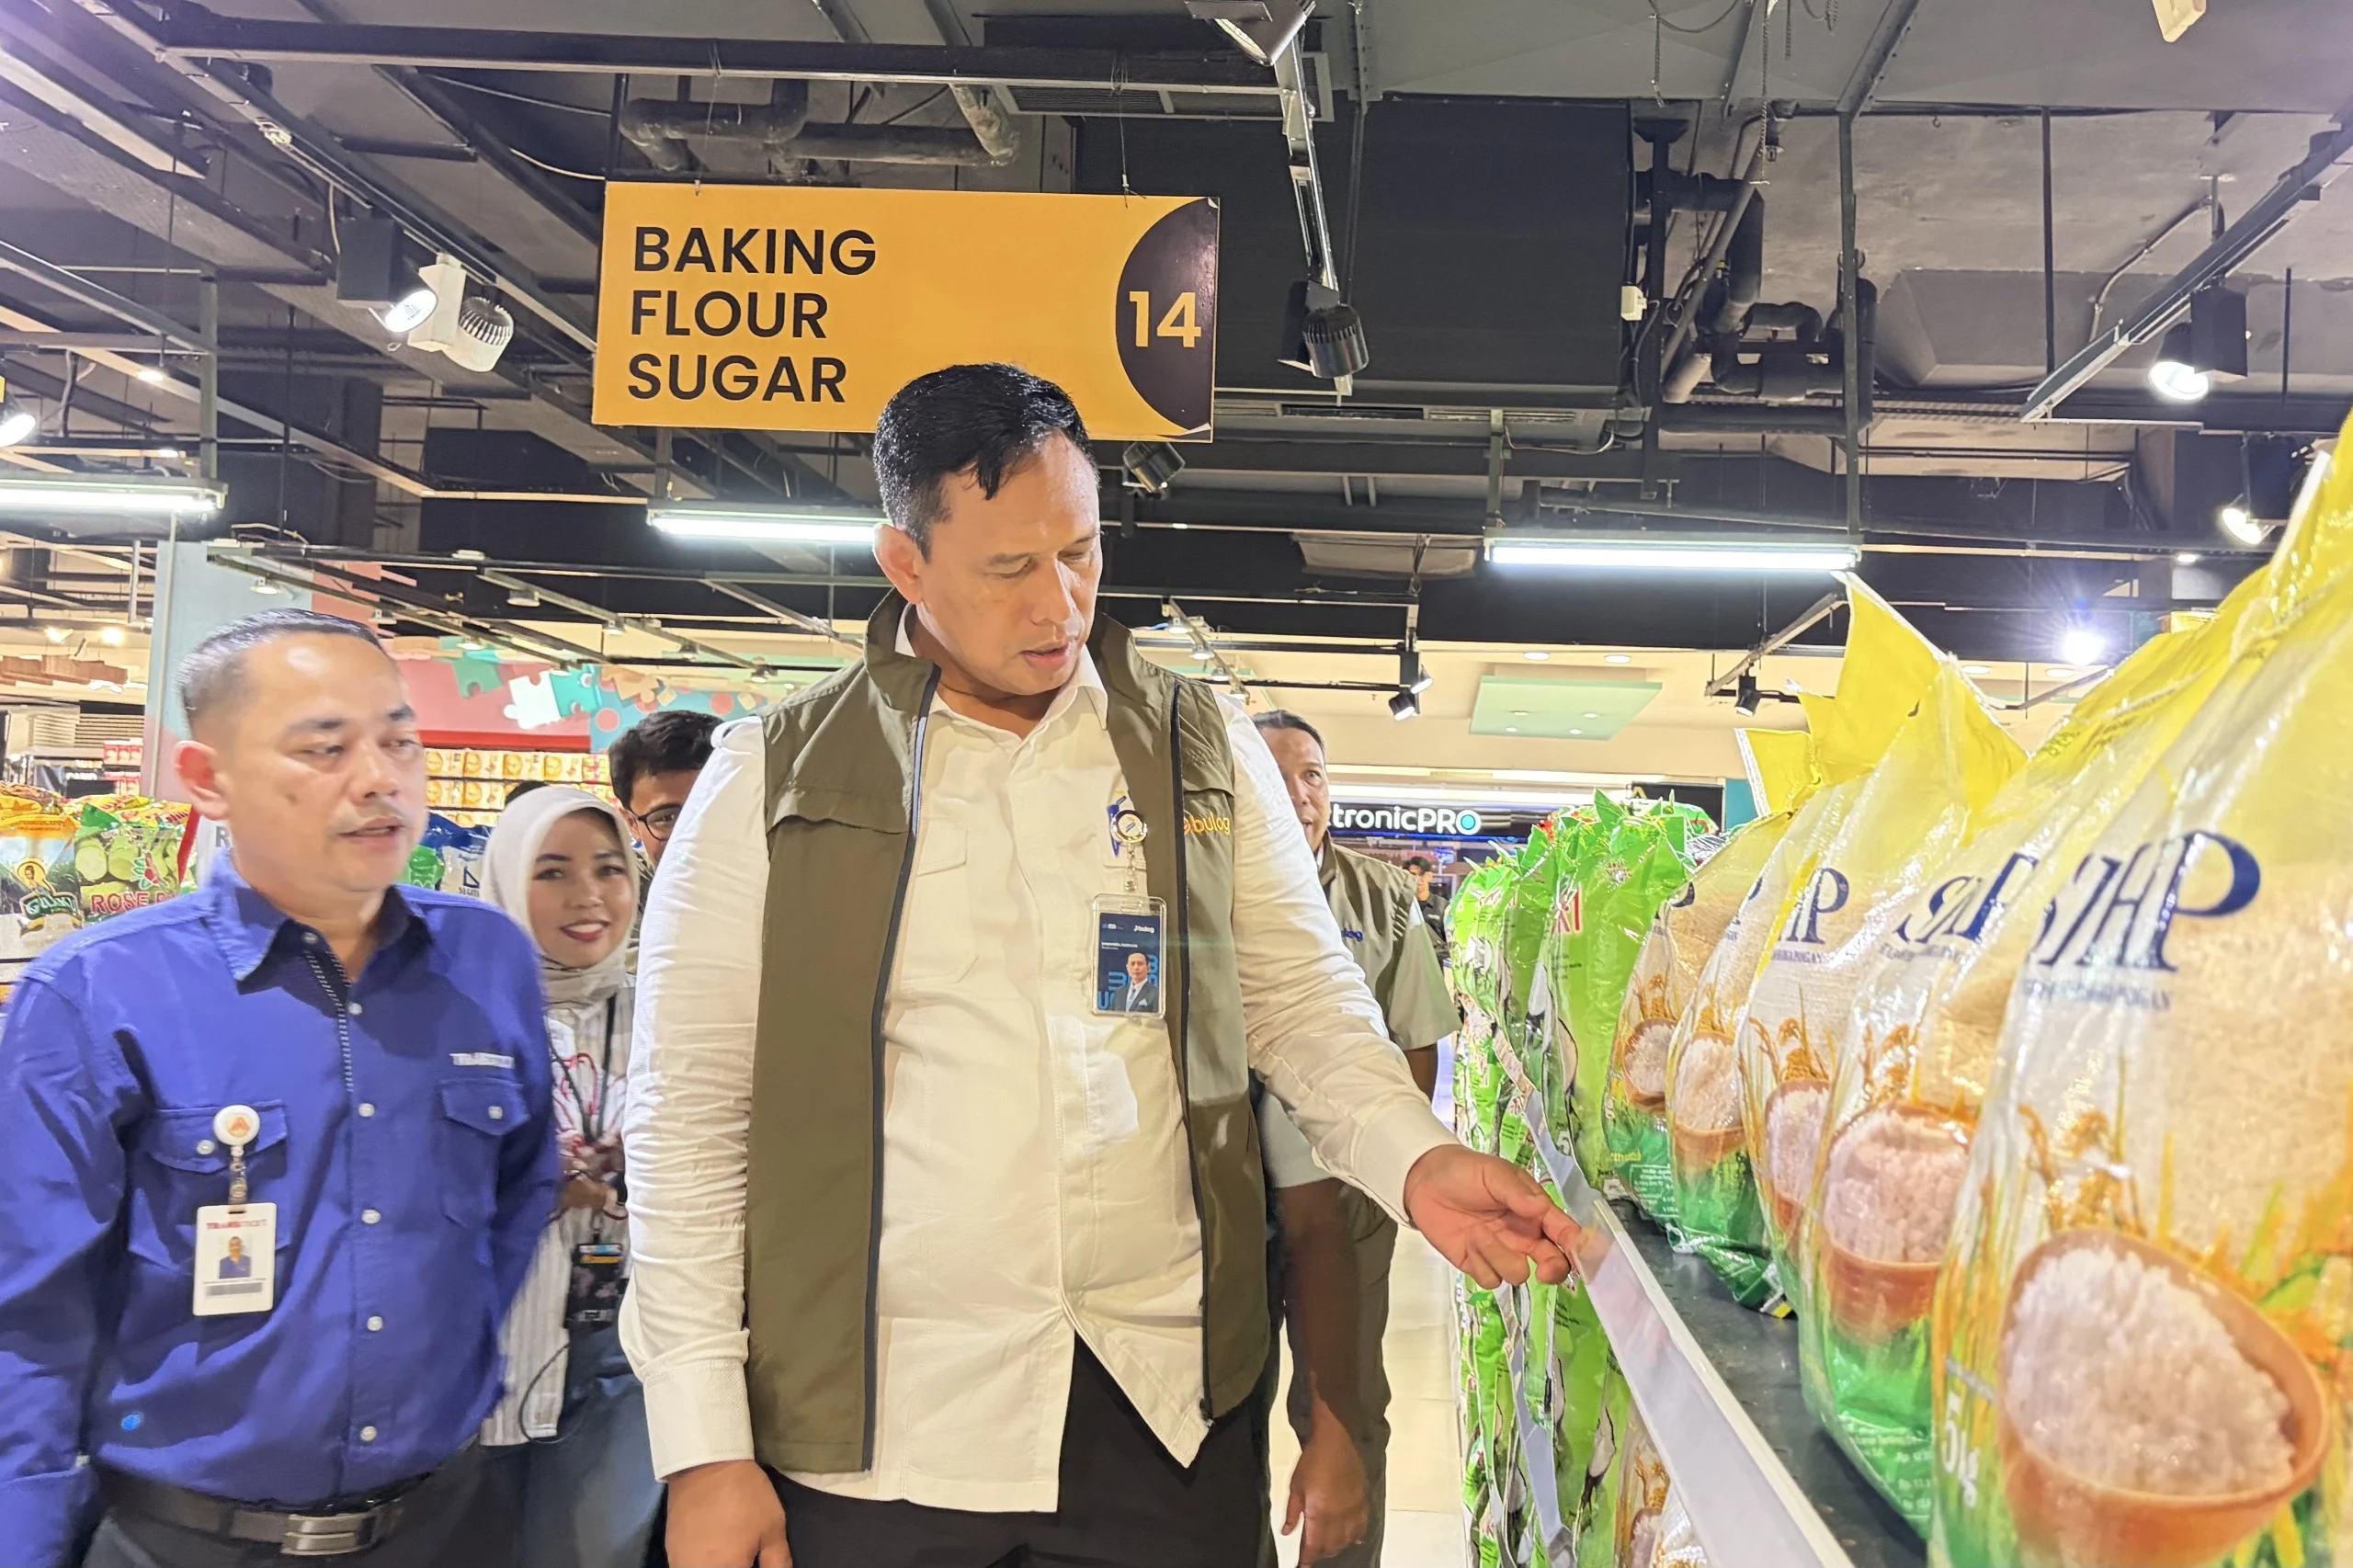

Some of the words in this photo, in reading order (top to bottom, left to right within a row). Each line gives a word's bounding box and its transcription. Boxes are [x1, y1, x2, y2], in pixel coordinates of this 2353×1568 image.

[634, 225, 877, 276] BAKING
[631, 289, 827, 339] FLOUR
[1129, 290, 1202, 348] 14
[627, 352, 847, 403] SUGAR
[1330, 802, 1482, 835] tronicPRO
[92, 892, 150, 914] ROSE
